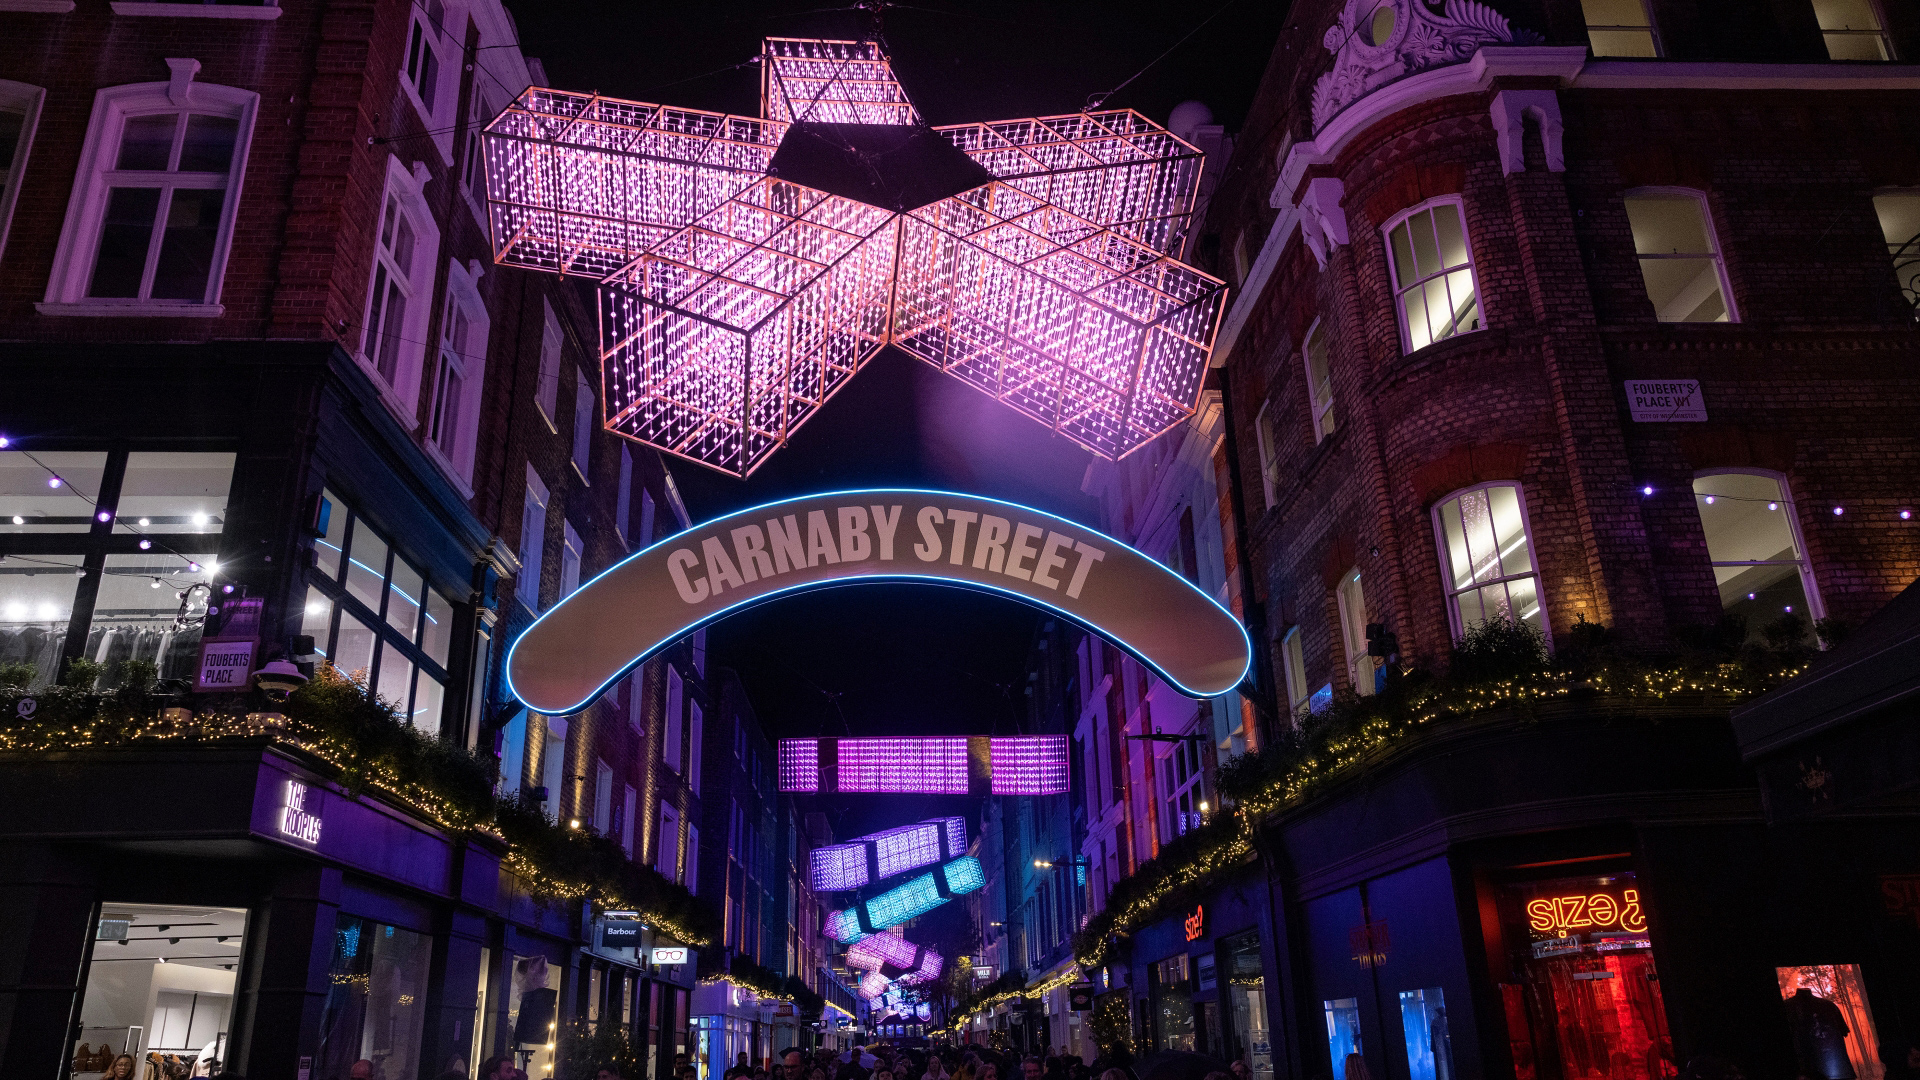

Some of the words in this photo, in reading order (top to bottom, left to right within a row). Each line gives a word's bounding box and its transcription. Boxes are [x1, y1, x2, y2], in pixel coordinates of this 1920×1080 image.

[1633, 383, 1695, 394] FOUBERT'S
[1636, 396, 1673, 408] PLACE
[1673, 396, 1692, 407] W1
[666, 505, 903, 604] CARNABY
[913, 506, 1106, 600] STREET
[204, 669, 234, 683] PLACE
[286, 780, 307, 811] THE
[282, 807, 323, 844] KOOPLES
[1184, 904, 1204, 942] size?
